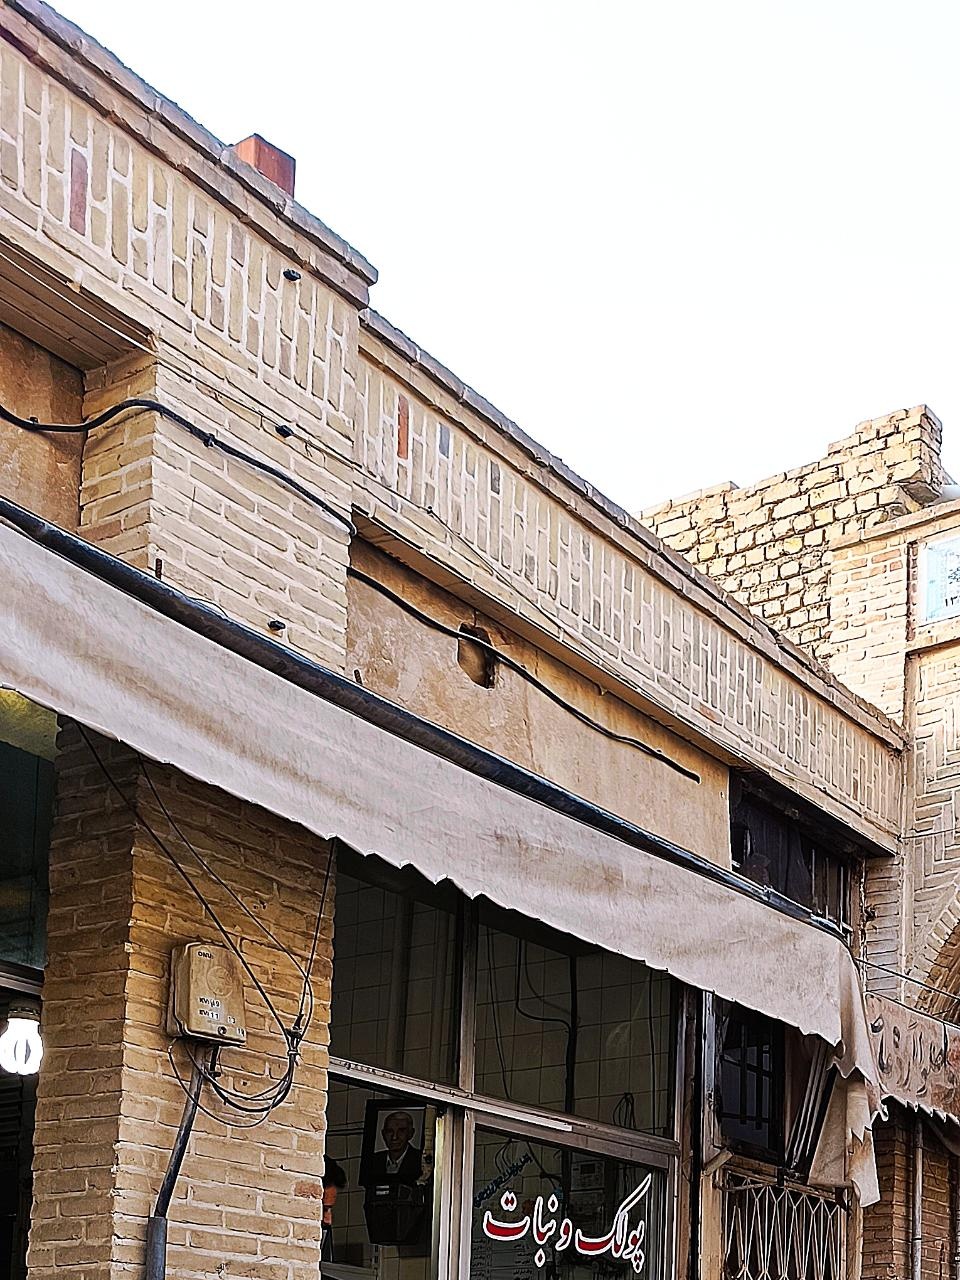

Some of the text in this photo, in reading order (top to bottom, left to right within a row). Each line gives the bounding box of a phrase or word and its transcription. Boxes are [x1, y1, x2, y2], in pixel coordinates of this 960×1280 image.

[483, 1190, 559, 1268] نبات
[555, 1218, 573, 1251] و
[575, 1172, 652, 1274] پولک
